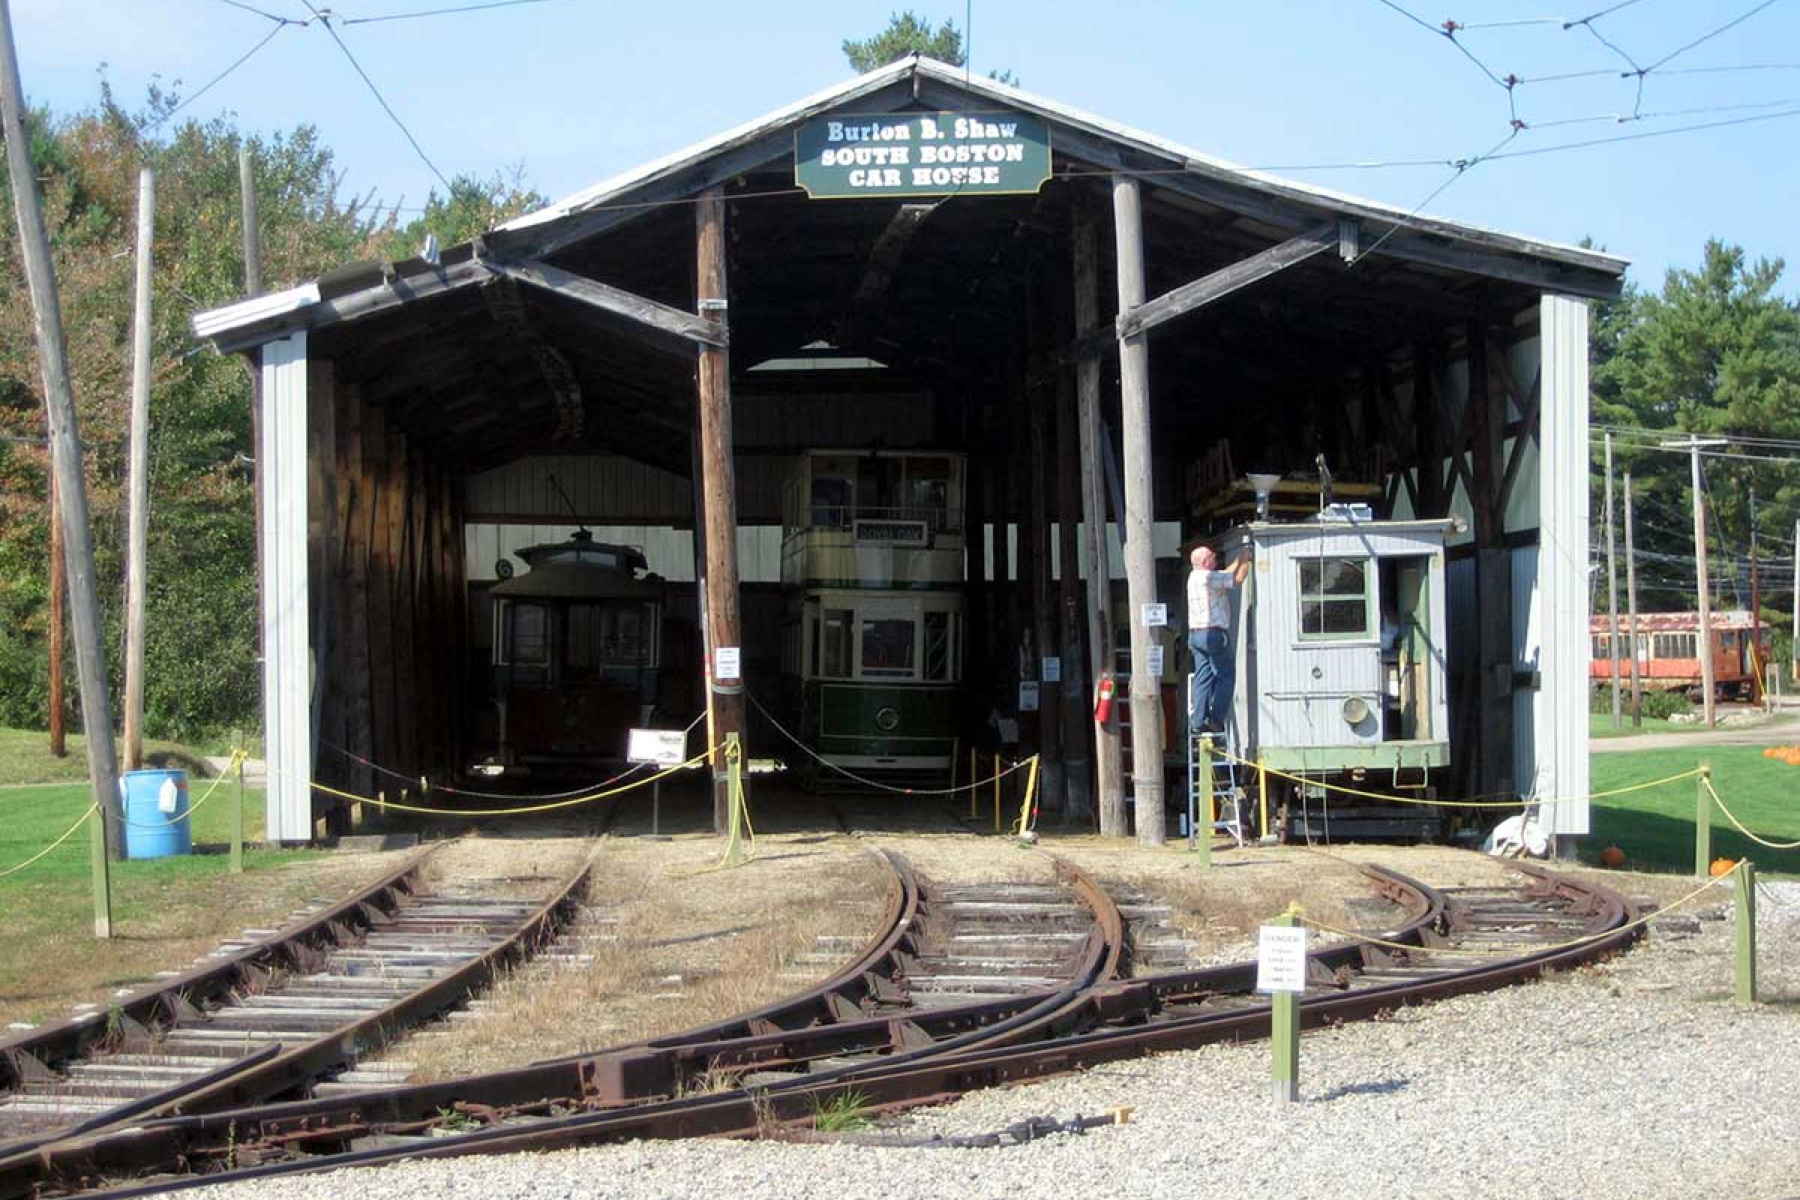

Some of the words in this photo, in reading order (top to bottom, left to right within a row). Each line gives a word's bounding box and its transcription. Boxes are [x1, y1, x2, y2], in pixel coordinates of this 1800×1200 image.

[827, 121, 910, 142] Burton
[920, 118, 944, 140] B.
[954, 117, 1017, 139] Shaw
[821, 146, 909, 166] SOUTH
[920, 144, 1024, 164] BOSTON
[849, 168, 902, 187] CAR
[912, 166, 1000, 186] HOUSE
